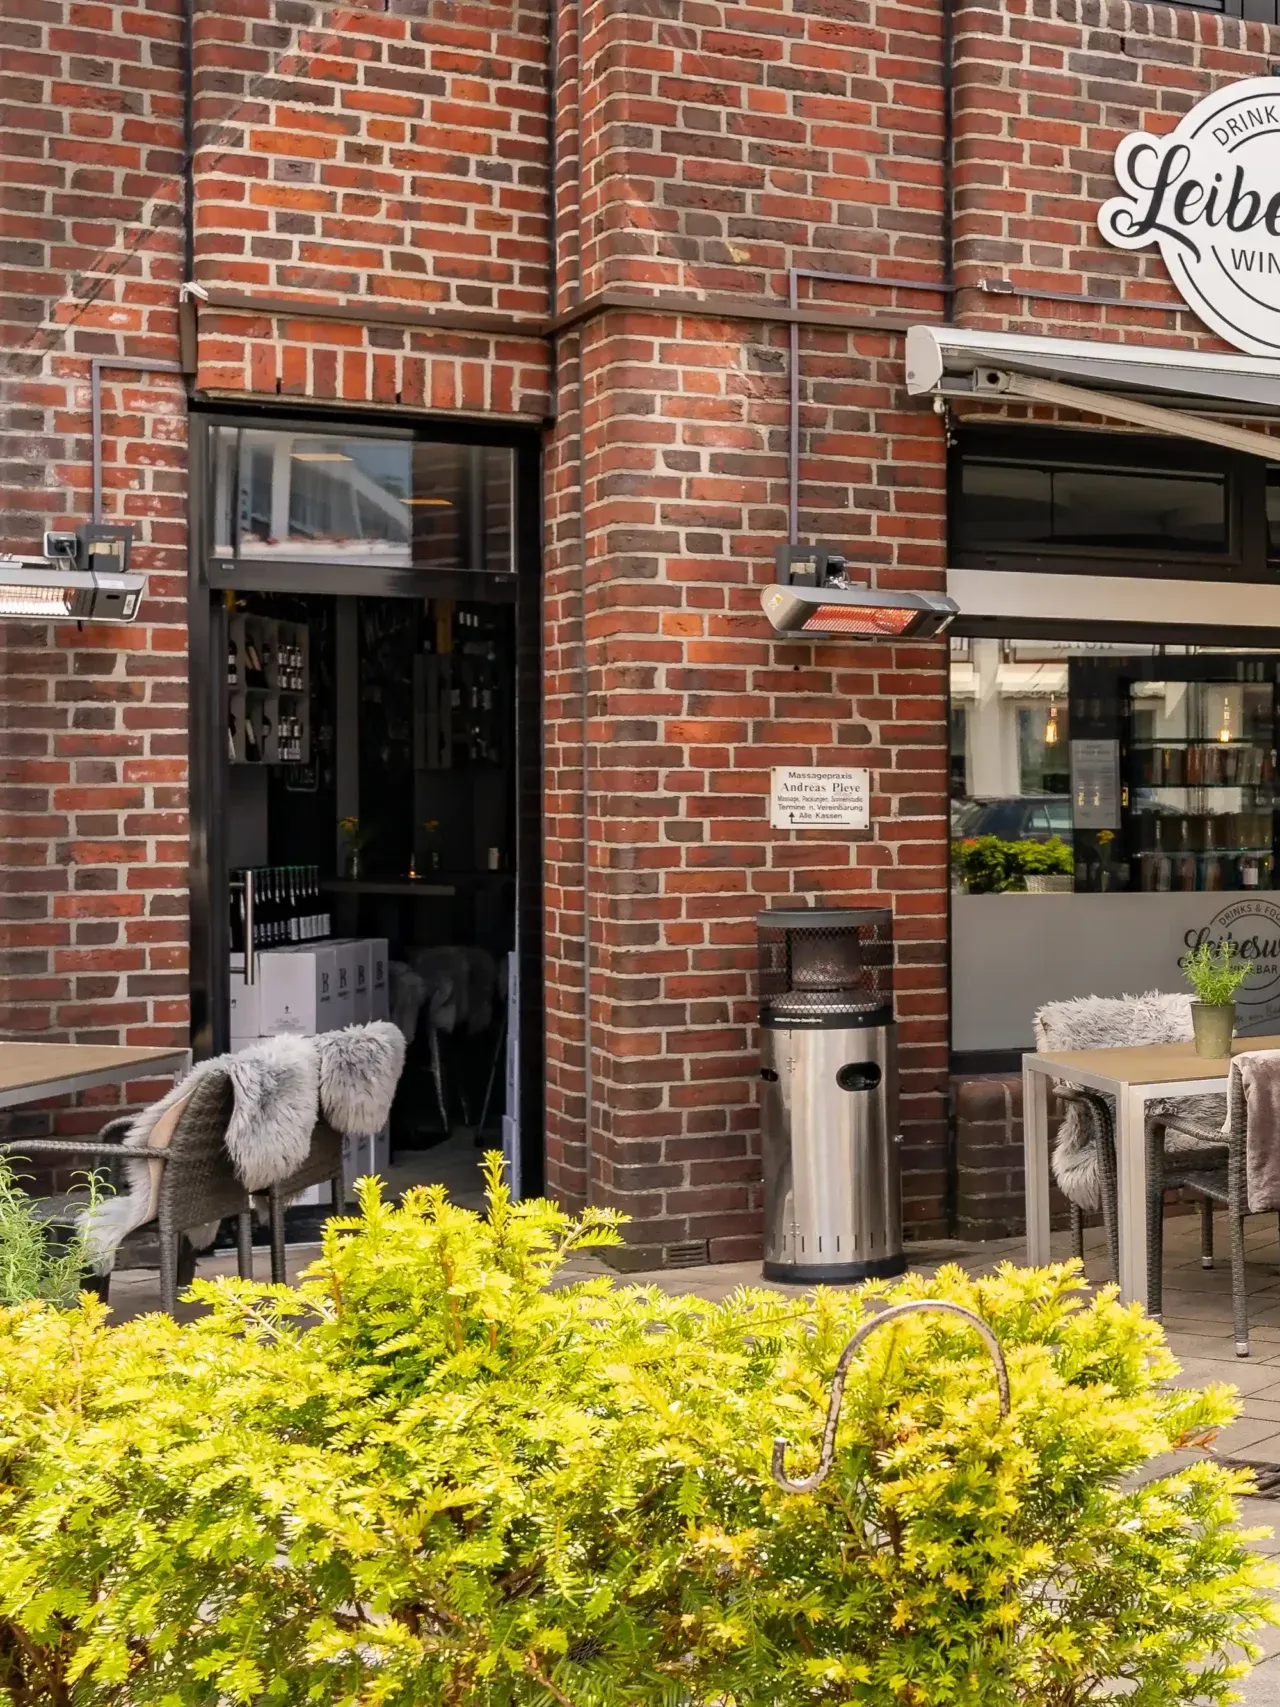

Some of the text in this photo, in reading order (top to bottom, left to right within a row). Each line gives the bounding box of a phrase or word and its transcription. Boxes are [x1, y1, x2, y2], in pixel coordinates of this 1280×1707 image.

[788, 771, 853, 780] Massagepraxis
[781, 782, 861, 795] Andreas Pleye
[778, 803, 806, 811] Termine
[817, 803, 864, 812] Vereinbarung
[1218, 904, 1252, 926] DRINKS
[1255, 903, 1262, 912] &
